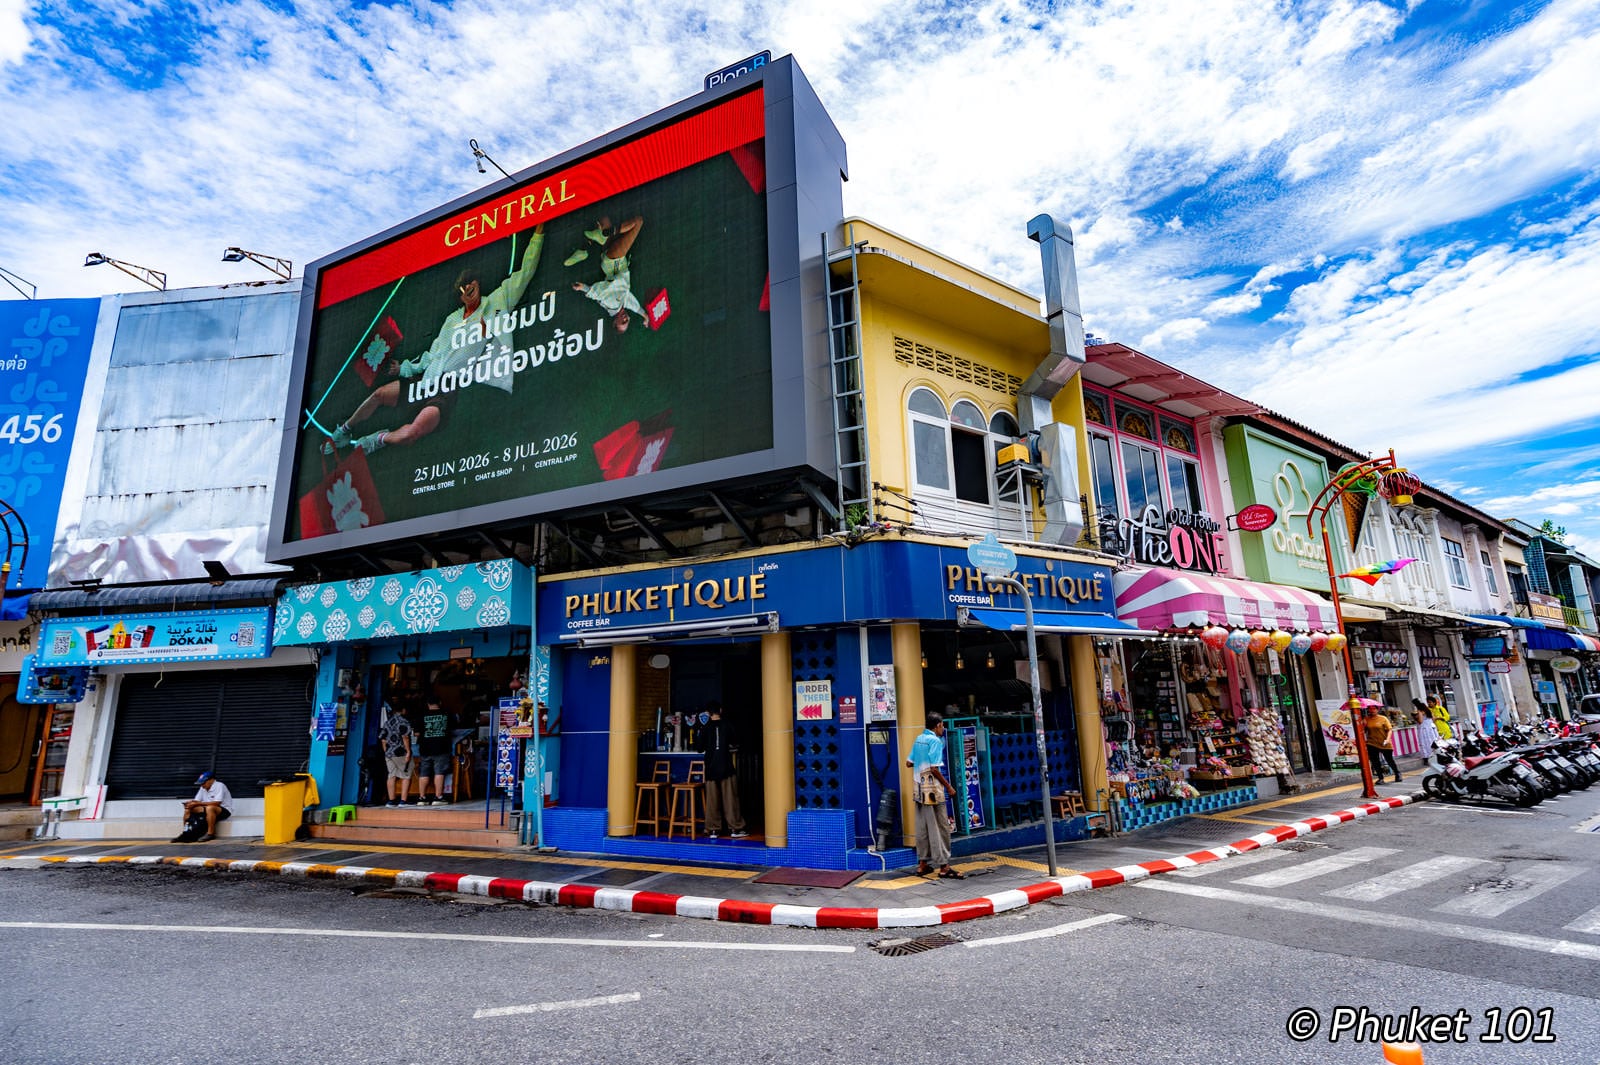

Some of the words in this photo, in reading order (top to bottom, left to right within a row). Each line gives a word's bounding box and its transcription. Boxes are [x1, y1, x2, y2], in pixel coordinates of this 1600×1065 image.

[444, 179, 576, 247] CENTRAL
[408, 318, 604, 403] แมตช์นี้ต้องช้อป
[414, 467, 429, 482] 25
[430, 461, 456, 481] JUN
[459, 452, 490, 472] 2026
[503, 448, 511, 462] 8
[513, 442, 540, 462] JUL
[543, 432, 578, 453] 2026
[534, 459, 563, 469] CENTRAL
[564, 454, 577, 463] APP
[475, 473, 491, 481] CHAT
[496, 468, 513, 477] SHOP
[412, 484, 437, 495] CENTRAL
[437, 480, 456, 490] STORE
[1119, 503, 1175, 564] The
[1169, 525, 1229, 574] ONE
[565, 574, 765, 617] PHUKETIQUE
[949, 594, 977, 605] COFFEE
[976, 597, 991, 605] BAR
[567, 619, 594, 629] COFFEE
[595, 618, 610, 626] BAR
[169, 636, 213, 646] DOKAN
[803, 693, 829, 702] THERE
